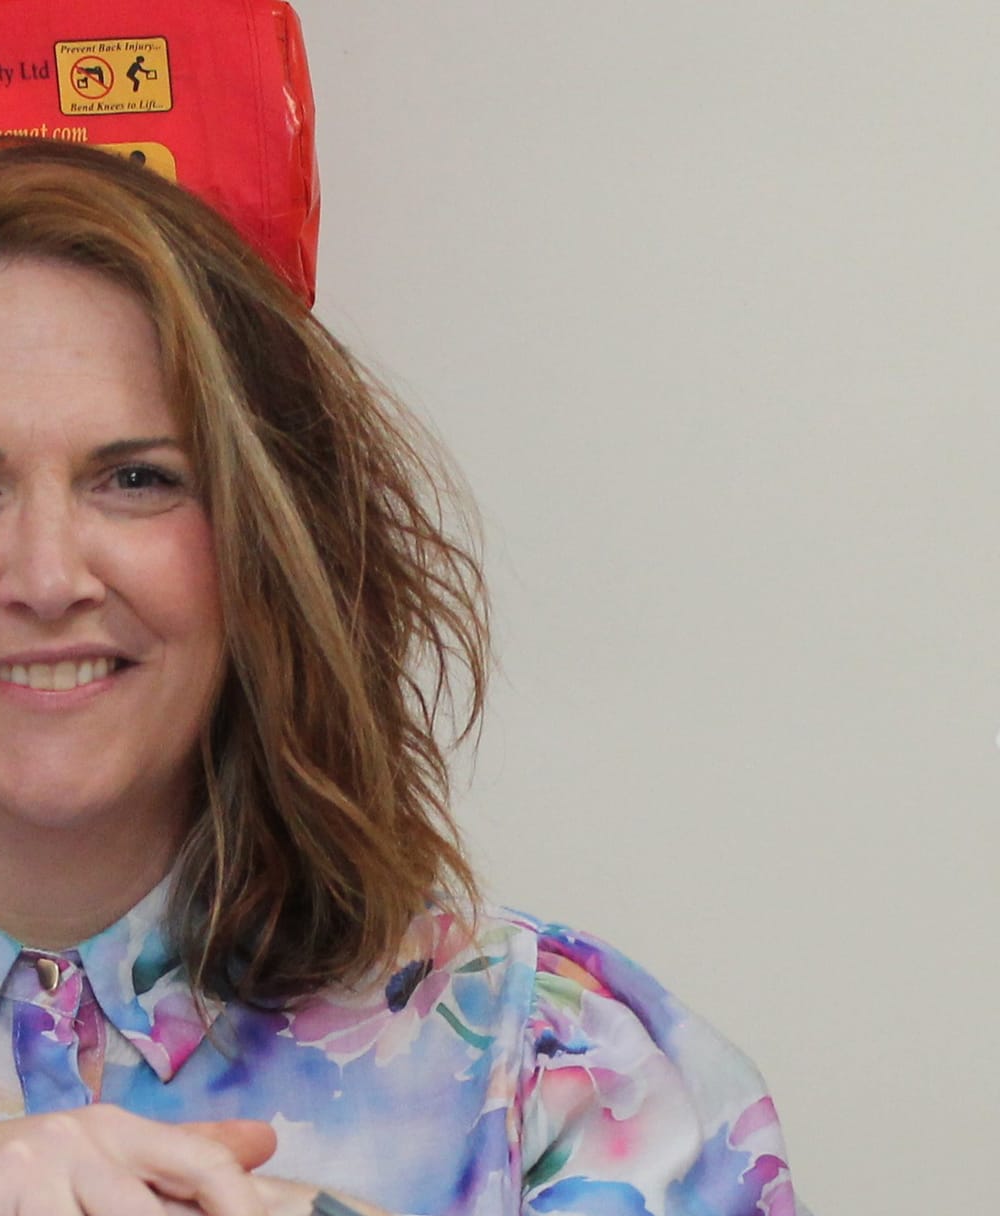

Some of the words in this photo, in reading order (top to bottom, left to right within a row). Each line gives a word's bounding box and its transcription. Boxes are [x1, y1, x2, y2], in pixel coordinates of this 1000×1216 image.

[60, 44, 95, 53] Prevent
[98, 43, 121, 52] Back
[20, 59, 50, 80] Ltd
[70, 103, 94, 112] Bend
[97, 101, 125, 112] Knees
[127, 101, 137, 110] to
